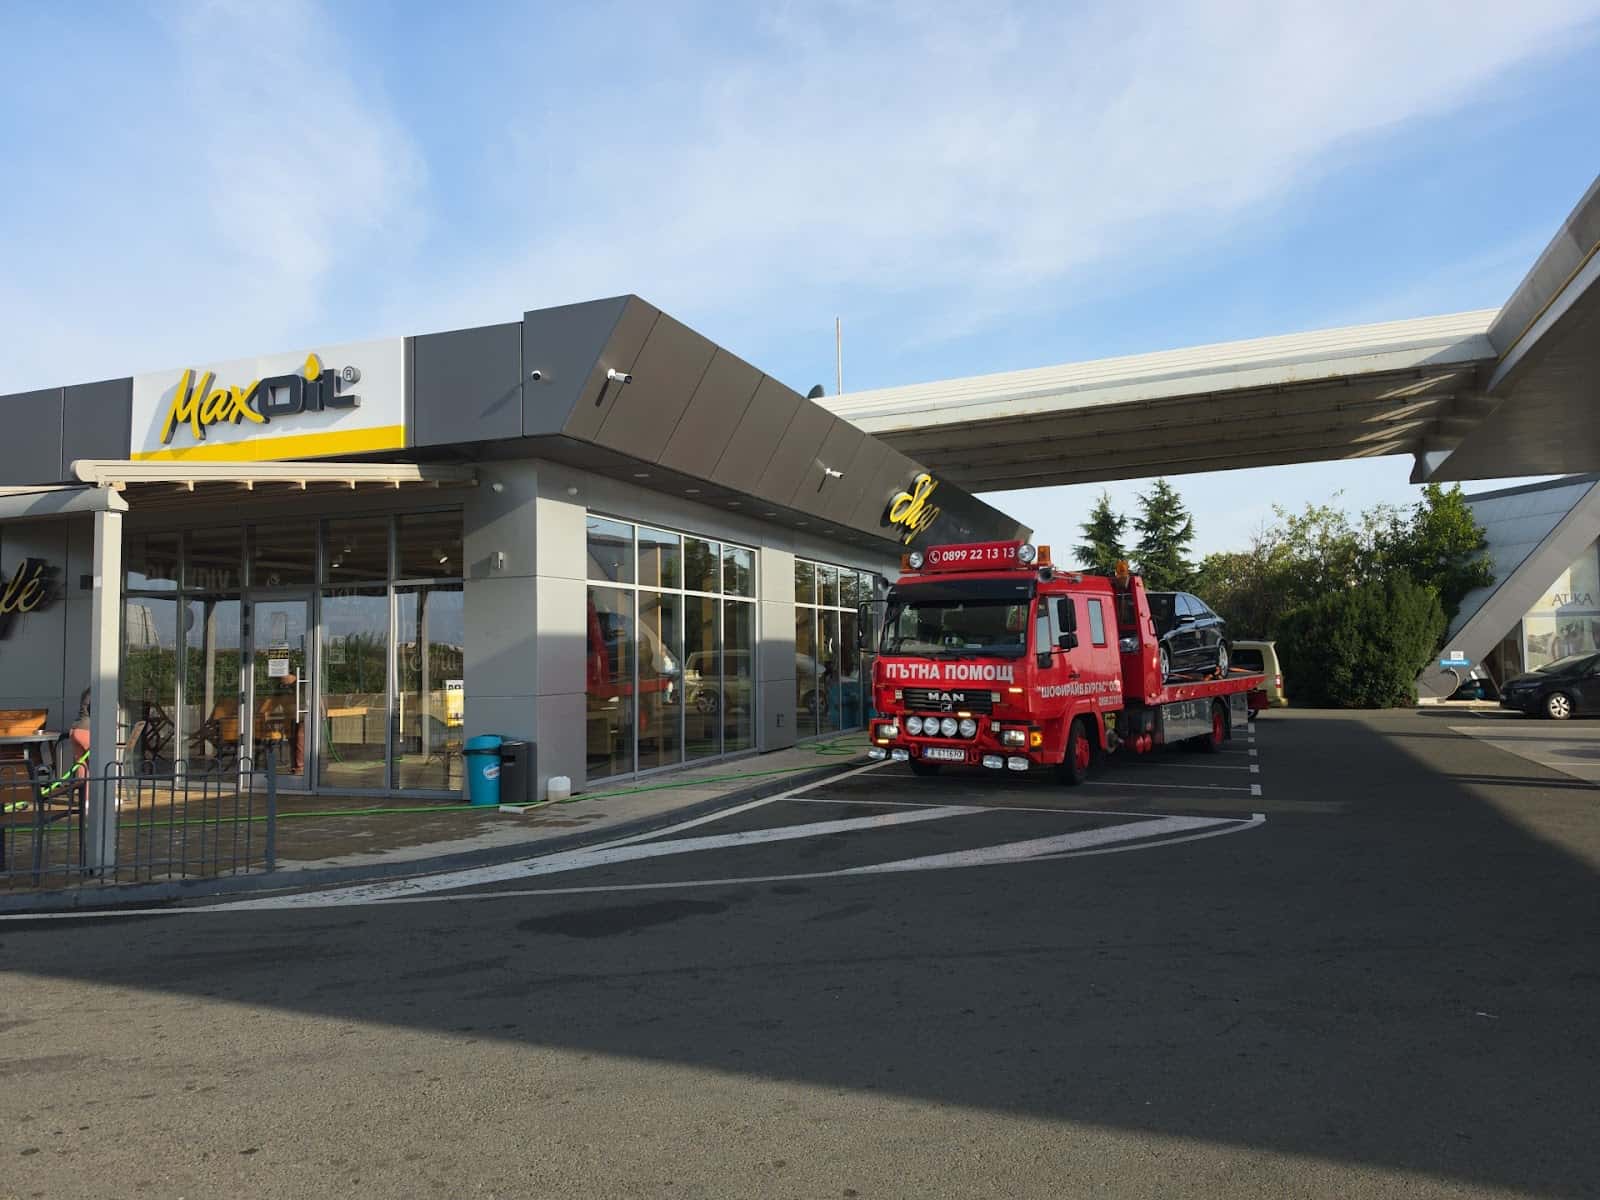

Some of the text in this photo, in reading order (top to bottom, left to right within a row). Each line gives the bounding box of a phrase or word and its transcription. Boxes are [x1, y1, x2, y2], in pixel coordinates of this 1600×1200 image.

[942, 547, 1015, 561] 0899 22 13 13
[886, 663, 1014, 684] ПЪТНА ПОМОЩ
[928, 692, 965, 702] MAN
